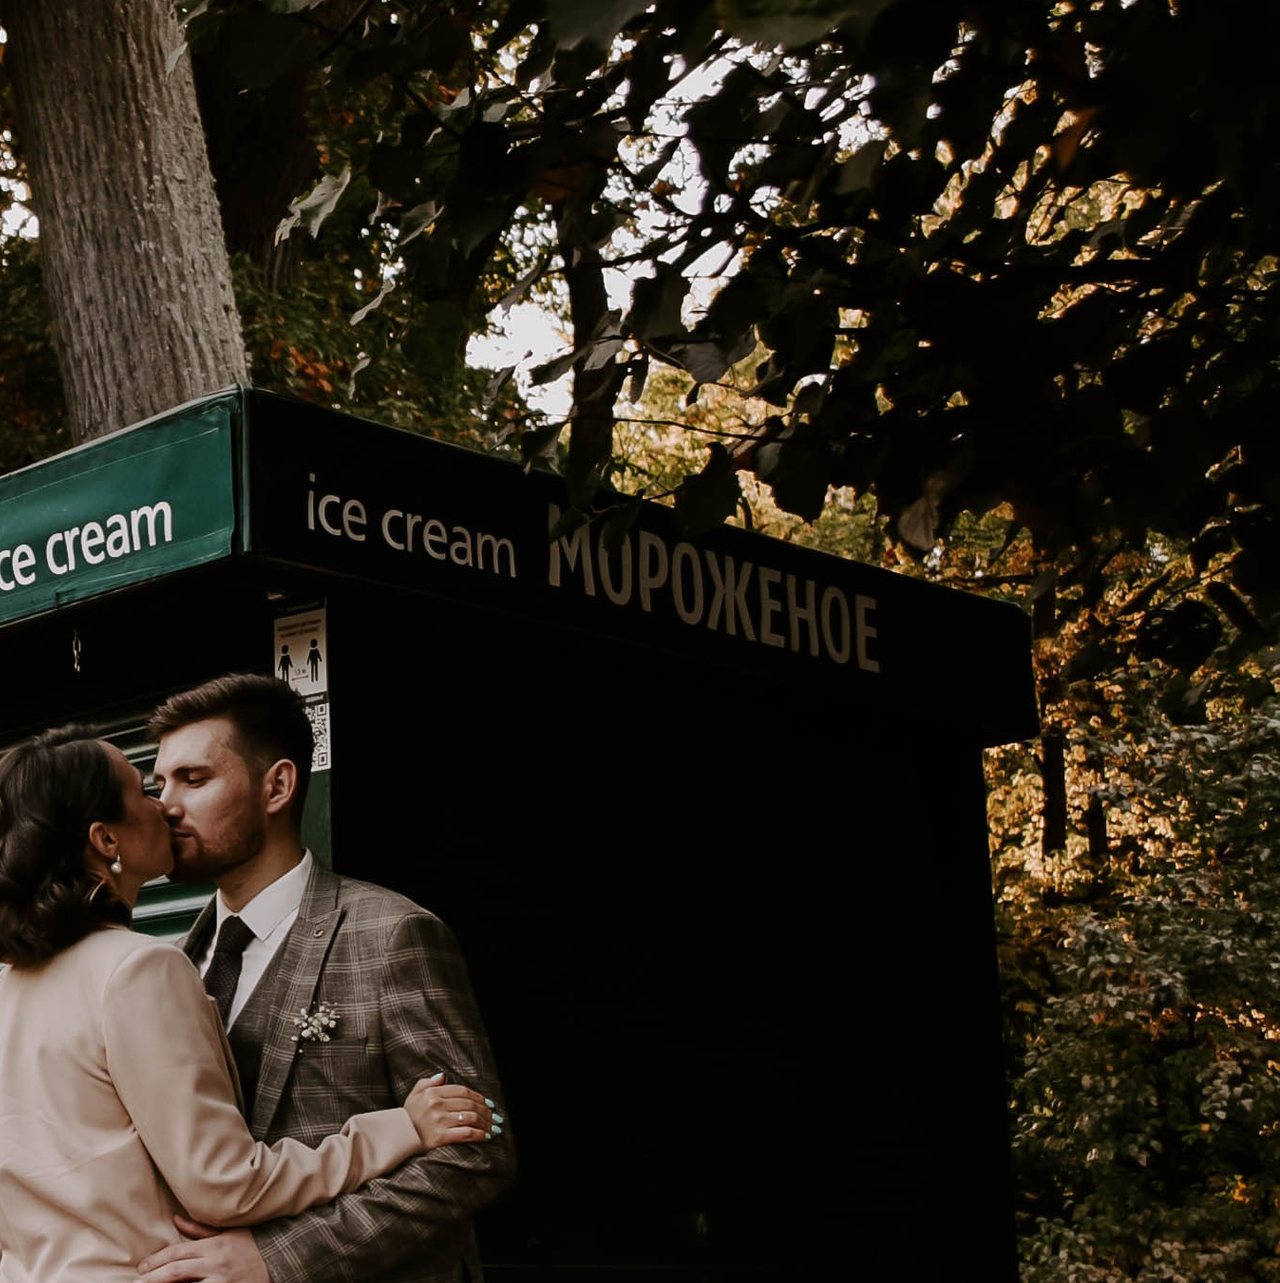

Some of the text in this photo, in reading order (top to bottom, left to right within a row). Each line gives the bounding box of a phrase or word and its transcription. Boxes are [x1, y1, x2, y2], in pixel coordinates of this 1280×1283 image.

[45, 500, 172, 576] cream
[307, 473, 516, 578] ice cream
[548, 503, 881, 673] МОРОЖЕНОЕ
